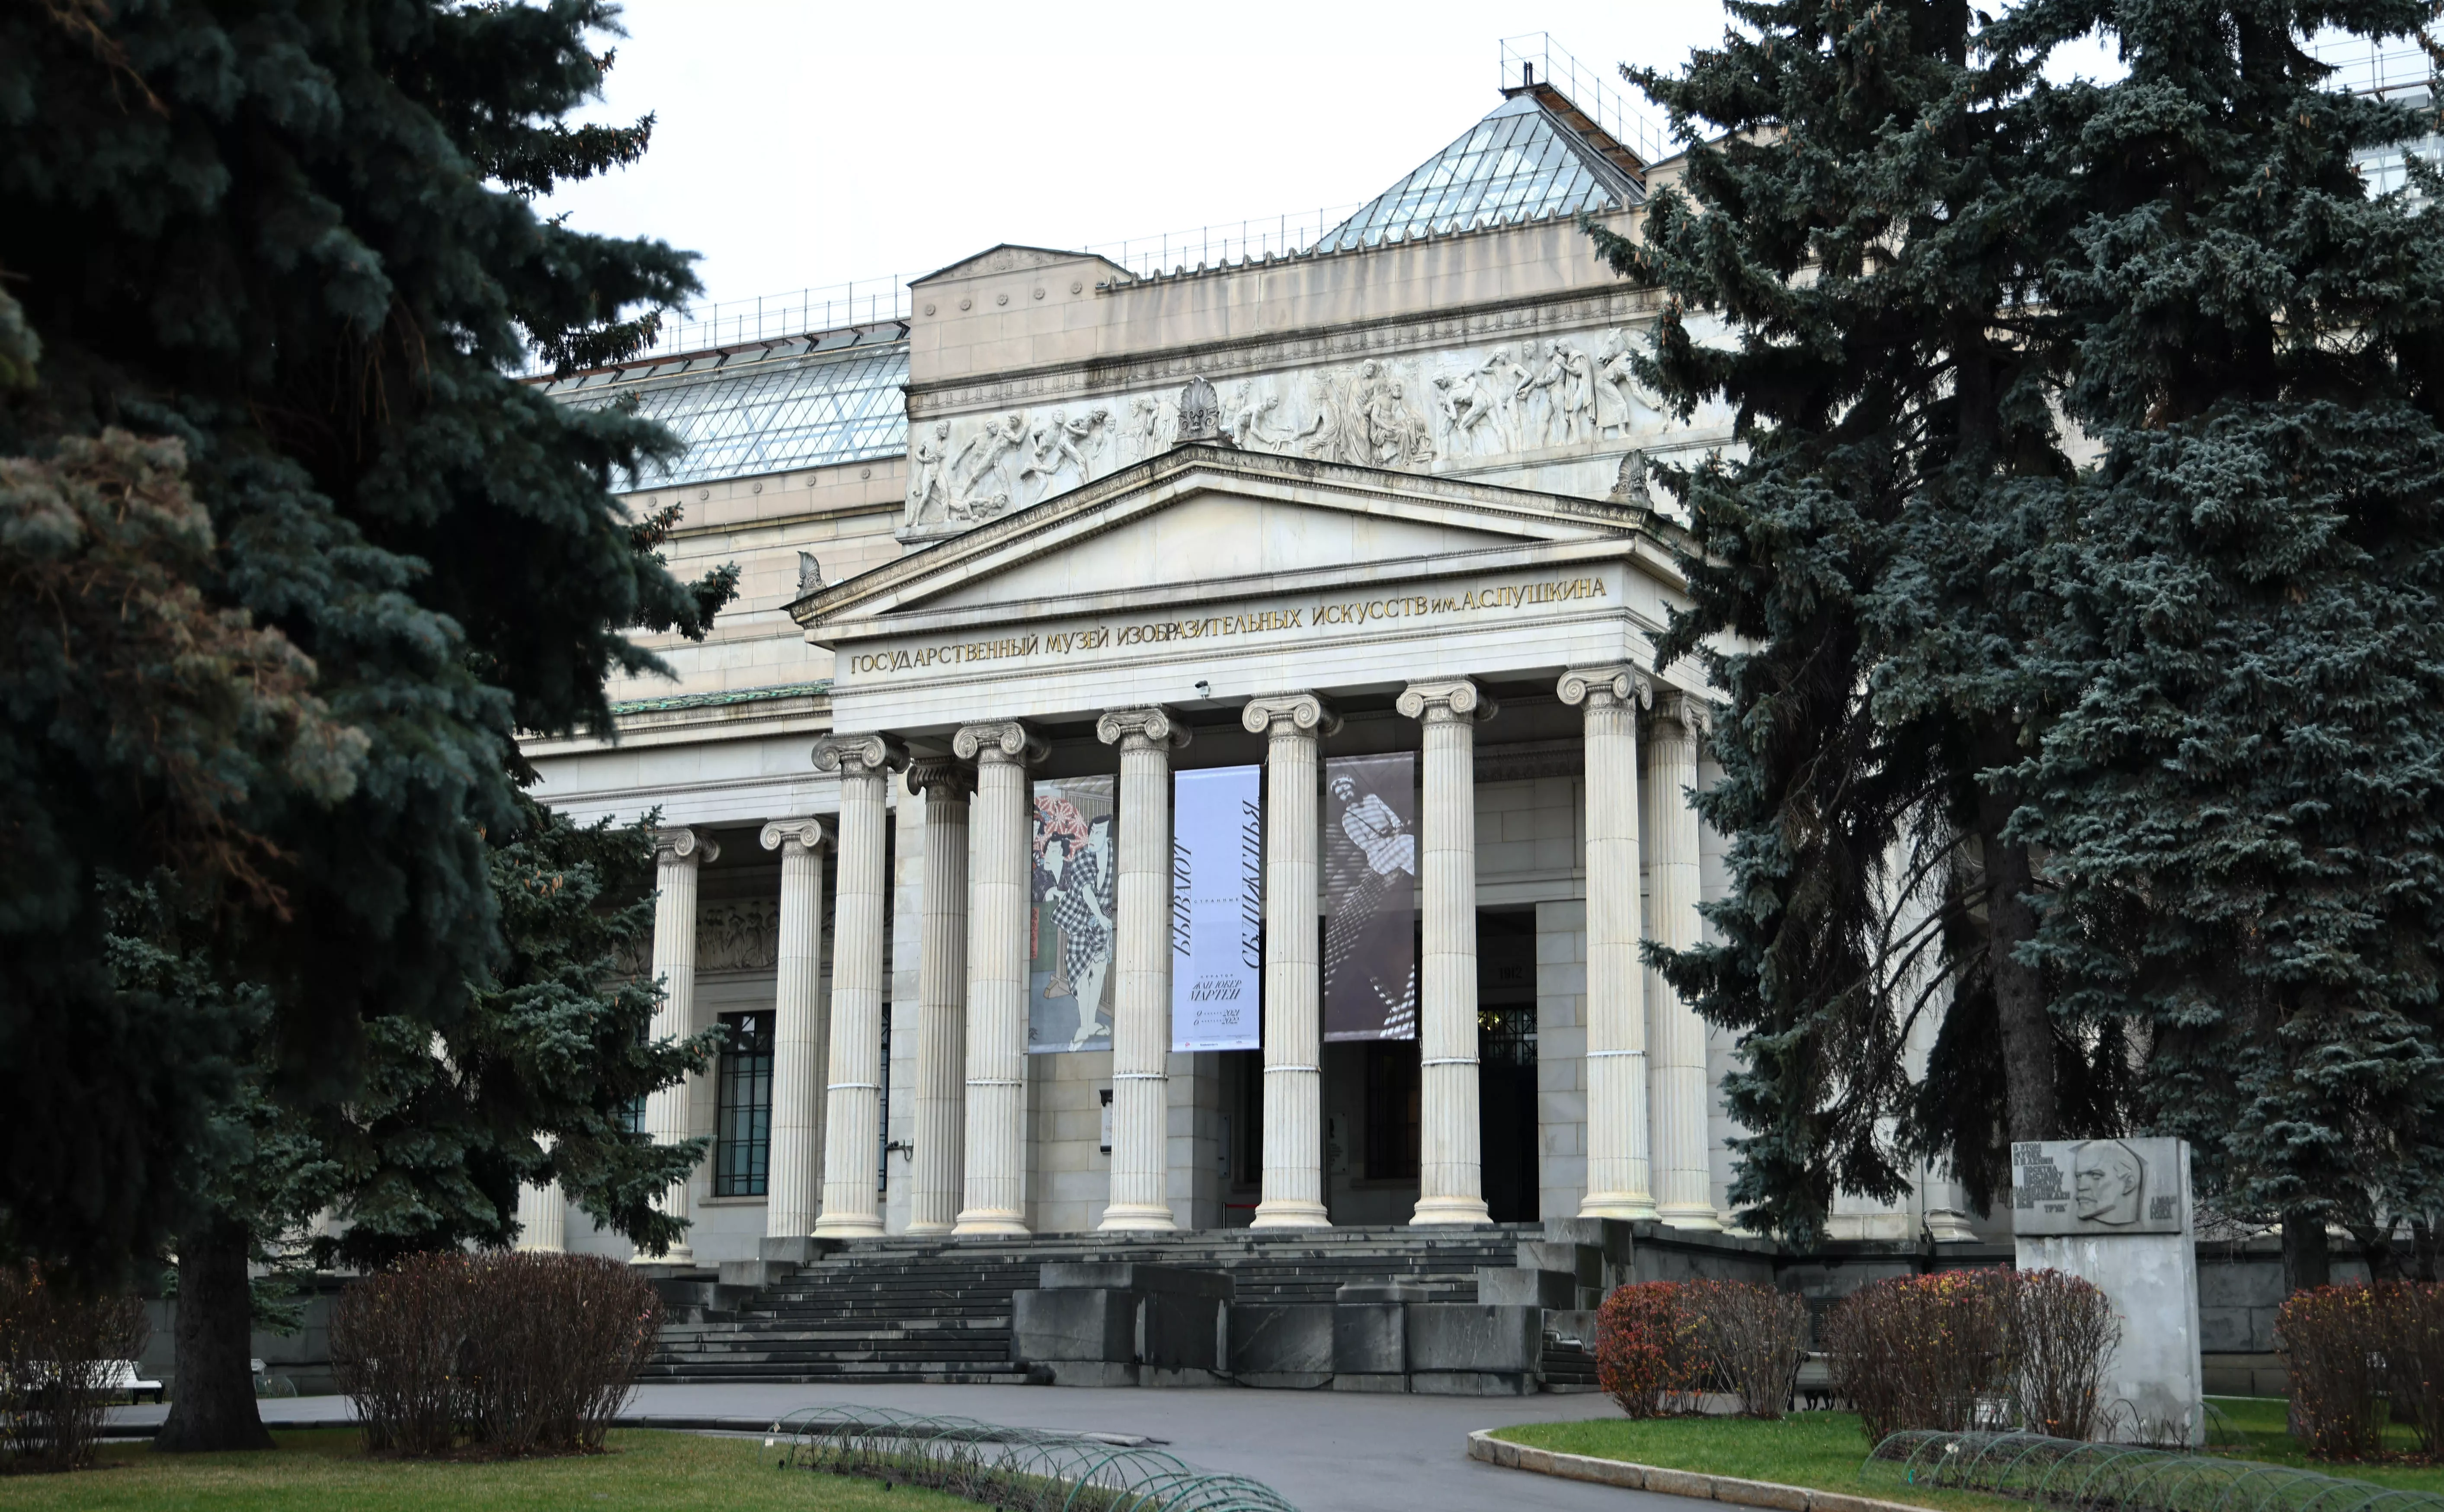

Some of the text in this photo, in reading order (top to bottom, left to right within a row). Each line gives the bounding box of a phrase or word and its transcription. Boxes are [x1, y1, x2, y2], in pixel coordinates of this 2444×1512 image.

[851, 631, 1039, 674] ГОСУДАРСТВЕННЫЙ
[1045, 625, 1109, 654] МУЗЕЙ
[1117, 609, 1302, 646] ИЗОБРАЗИТЕЛЬНЫХ
[1312, 596, 1428, 626] ИСКУССТВ
[1173, 836, 1192, 959] БЫВАЮТ
[1188, 988, 1241, 1001] МАРТЕН
[1215, 979, 1242, 989] ЮБЕР
